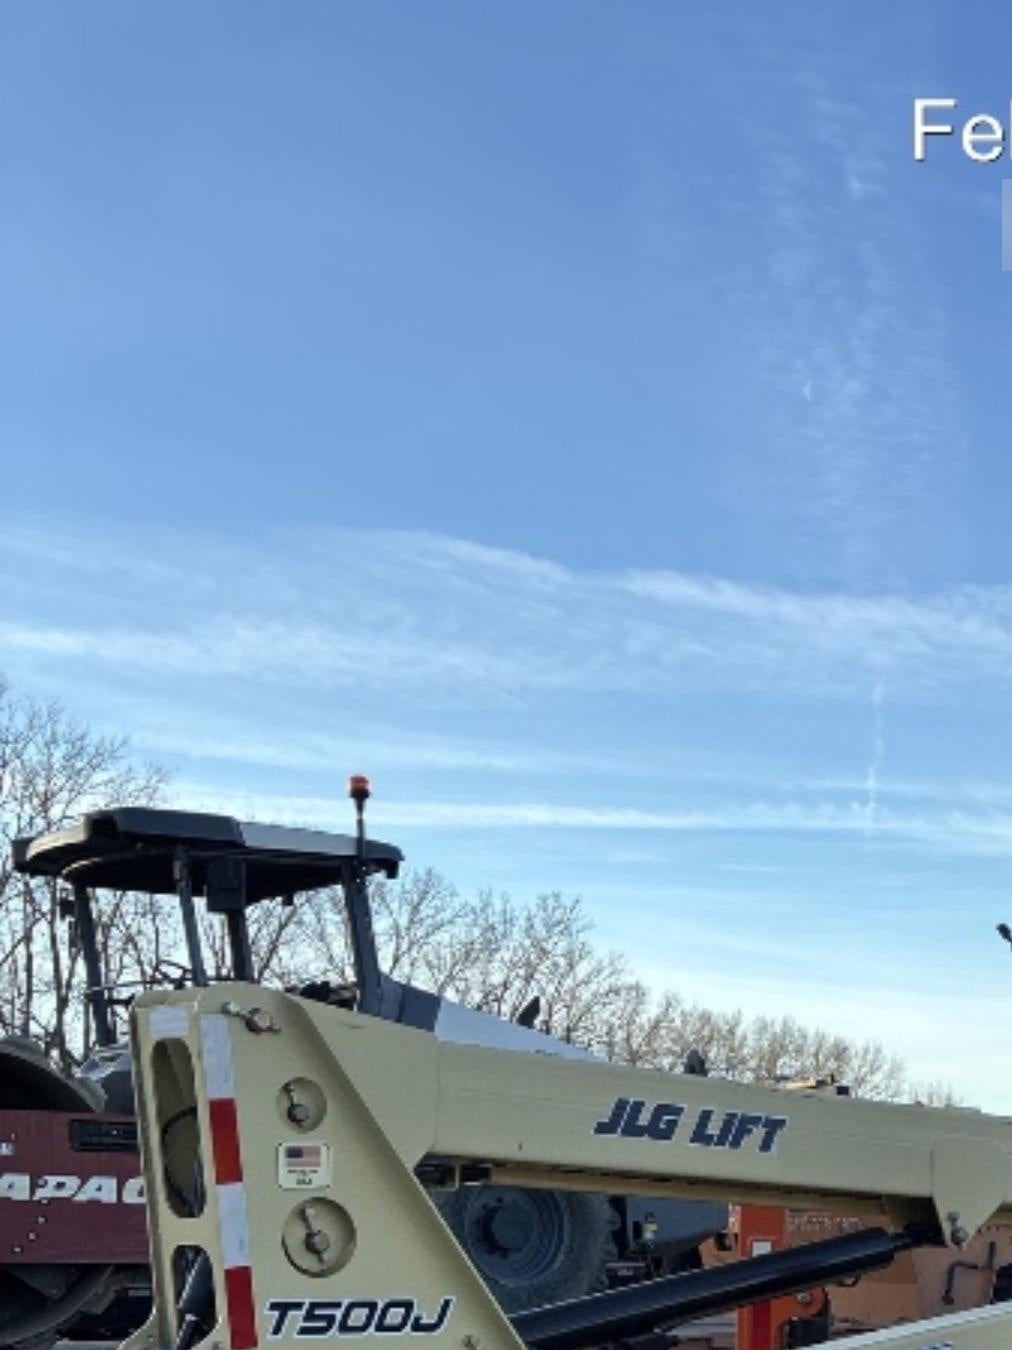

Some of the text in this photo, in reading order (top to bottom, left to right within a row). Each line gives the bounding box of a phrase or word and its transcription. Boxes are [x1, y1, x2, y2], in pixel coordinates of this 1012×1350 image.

[593, 1097, 787, 1153] JLG LIFT
[266, 1297, 455, 1338] T500J
